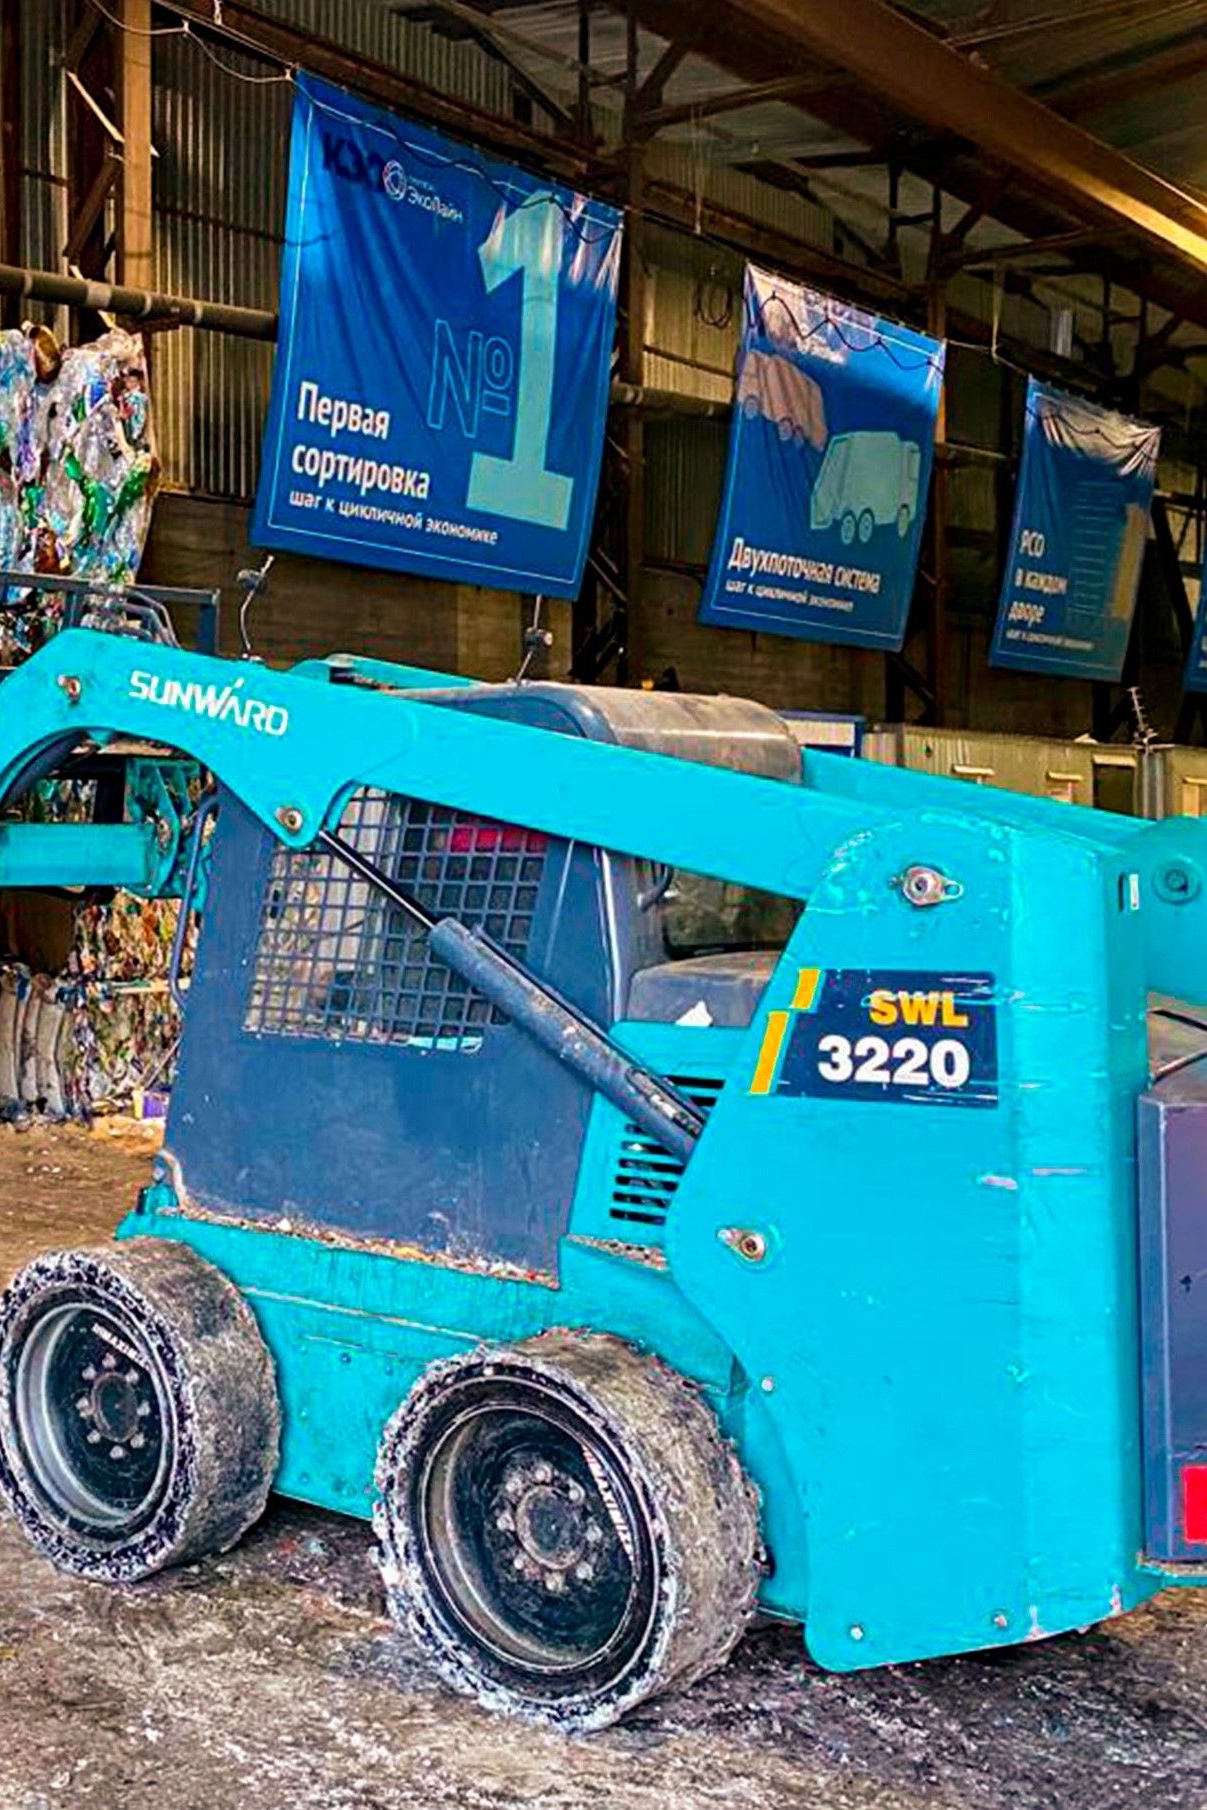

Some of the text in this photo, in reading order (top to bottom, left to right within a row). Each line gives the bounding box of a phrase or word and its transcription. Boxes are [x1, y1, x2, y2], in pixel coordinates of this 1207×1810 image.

[466, 190, 574, 531] 1
[297, 381, 390, 440] Первая
[292, 445, 431, 499] сортировка
[289, 490, 499, 545] шаг к цикличной экономике
[727, 537, 831, 583] Двухпоточная
[129, 670, 289, 736] SUNWARD
[868, 990, 969, 1028] SWL
[817, 1034, 971, 1088] 3220
